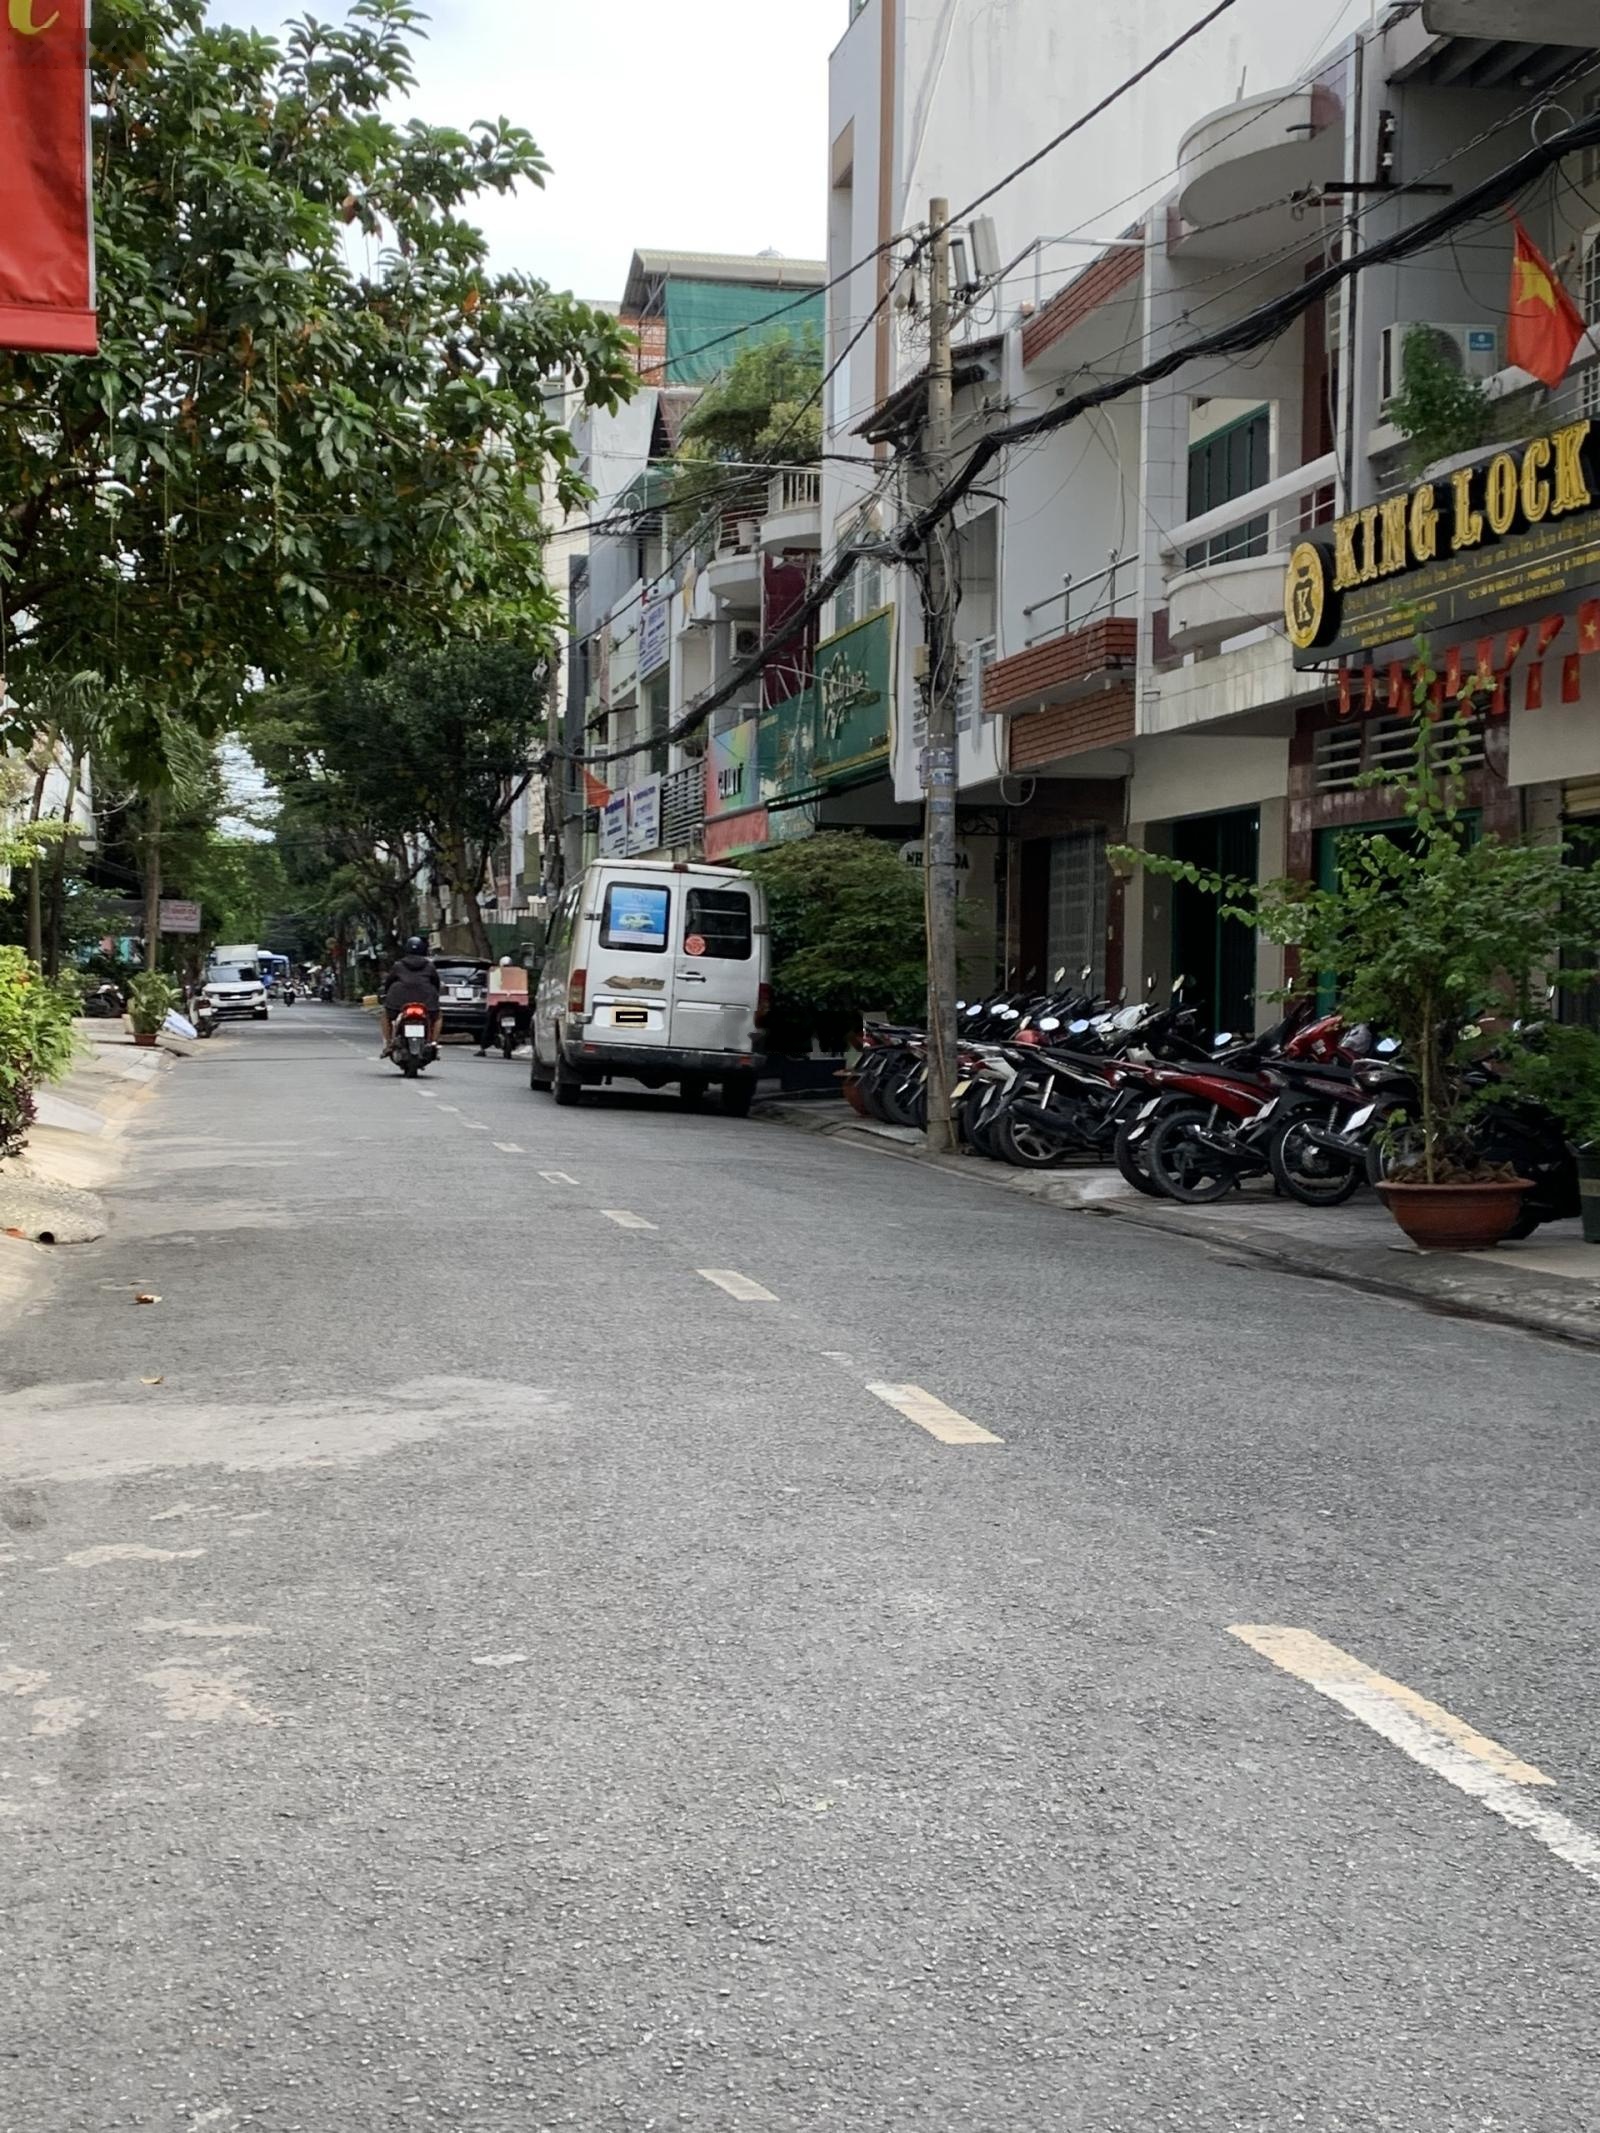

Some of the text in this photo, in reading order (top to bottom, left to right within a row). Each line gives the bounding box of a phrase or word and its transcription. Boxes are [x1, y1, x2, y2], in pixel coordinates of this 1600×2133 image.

[1333, 484, 1440, 592] KING
[1451, 419, 1592, 551] LOCK
[1296, 586, 1312, 624] K
